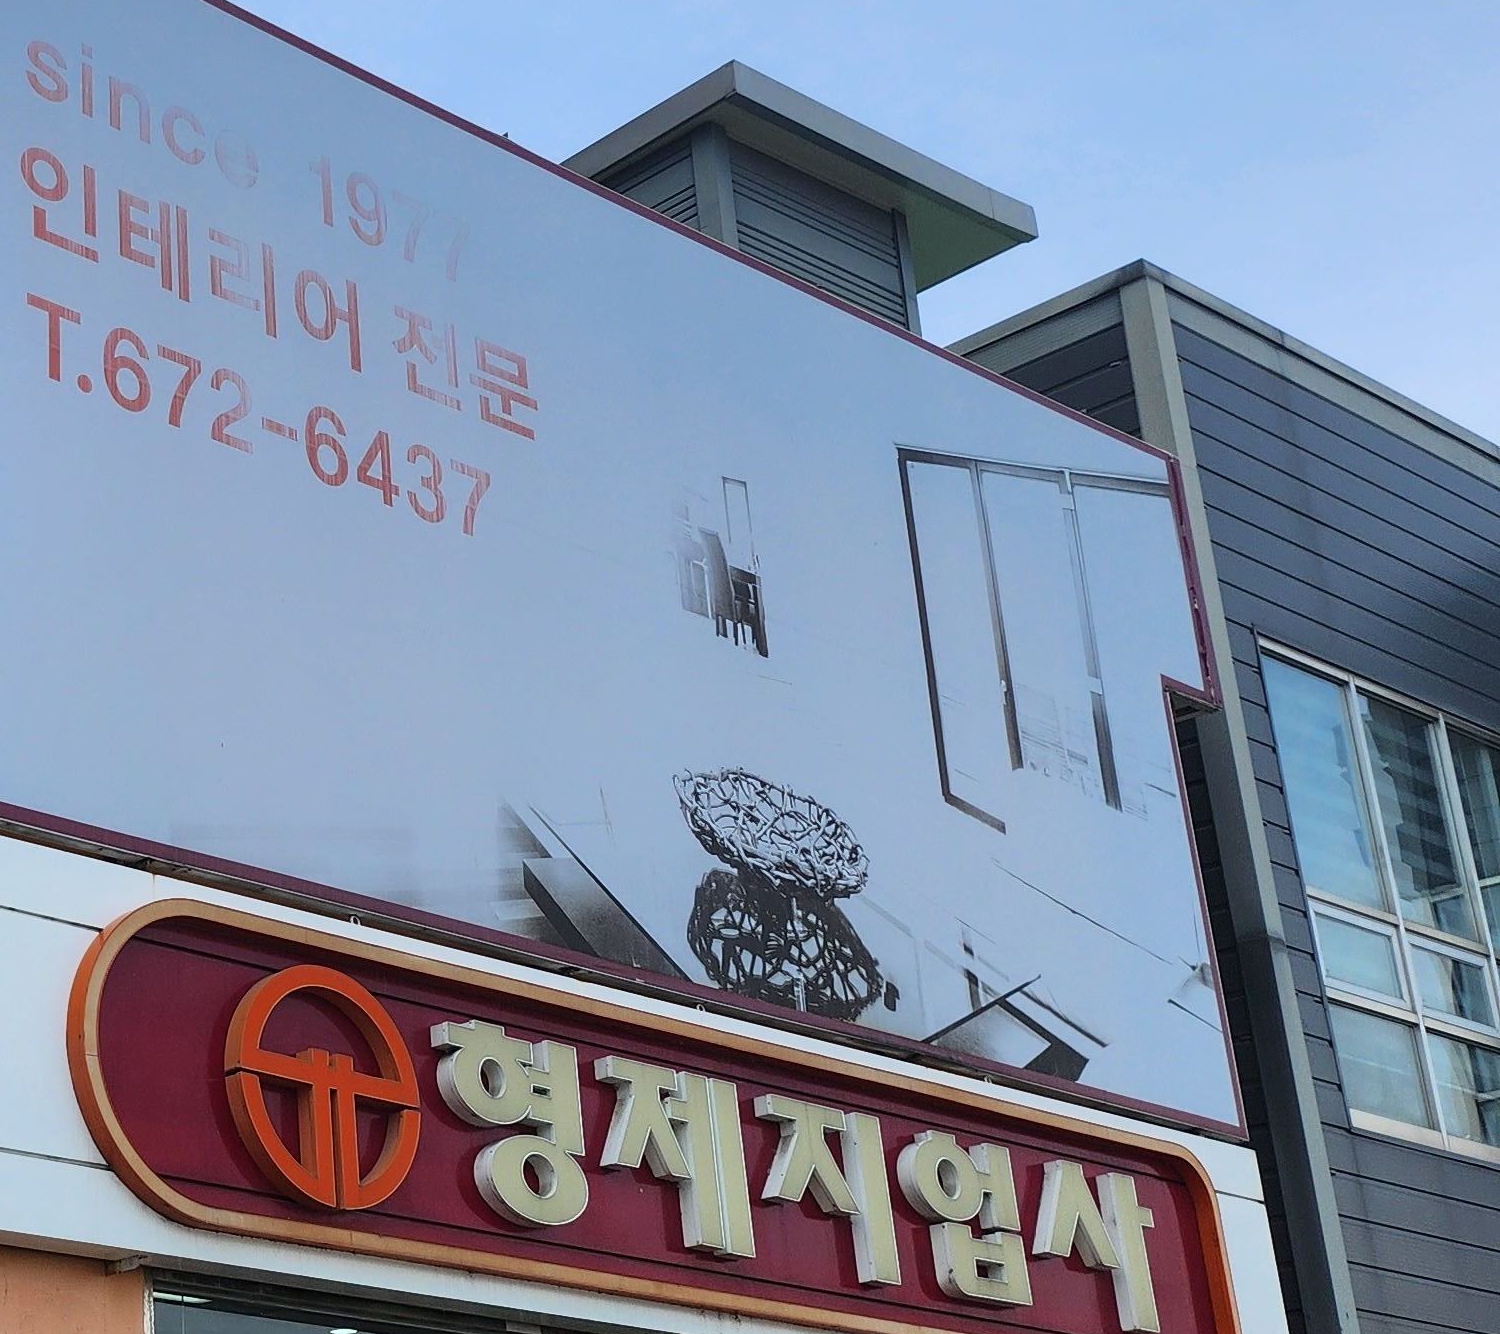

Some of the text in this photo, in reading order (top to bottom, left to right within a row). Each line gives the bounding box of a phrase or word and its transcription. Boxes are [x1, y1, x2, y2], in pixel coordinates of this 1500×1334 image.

[19, 147, 540, 441] 인테리어 전문
[26, 40, 472, 282] since 1977
[25, 291, 492, 538] T.672-6437
[429, 1017, 1162, 1334] 형제지업사
